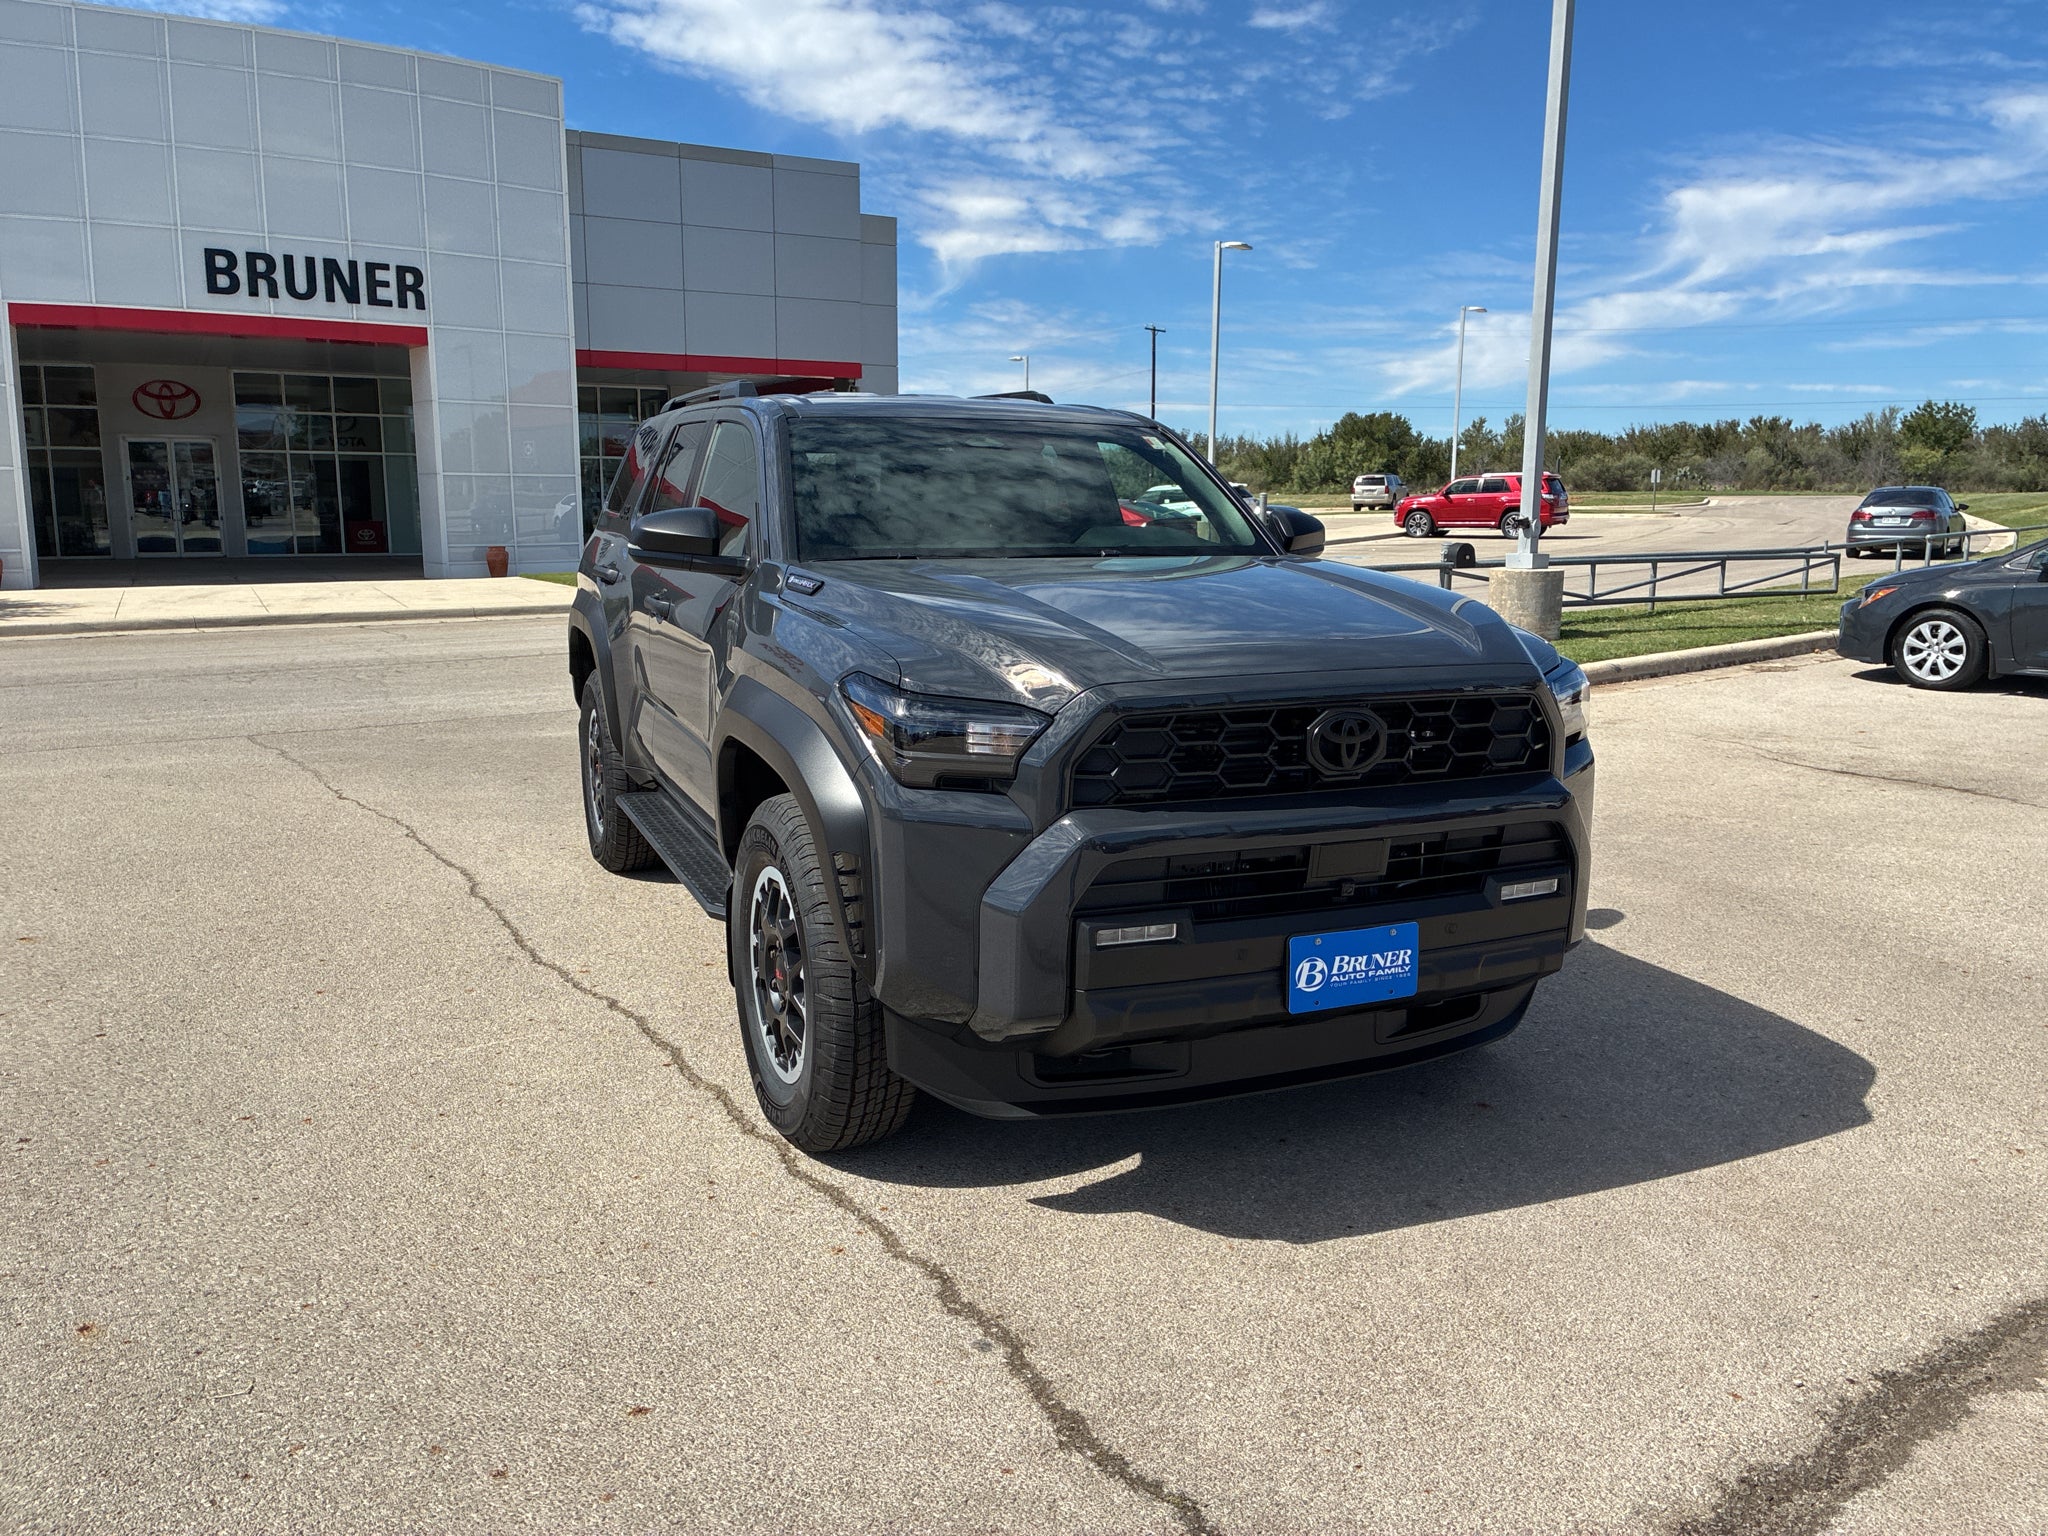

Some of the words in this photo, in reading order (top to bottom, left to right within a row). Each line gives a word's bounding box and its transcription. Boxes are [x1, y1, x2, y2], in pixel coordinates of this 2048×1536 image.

[204, 247, 426, 311] BRUNER
[1330, 949, 1412, 975] BRUNER
[1330, 972, 1366, 983] AUTO
[1368, 965, 1411, 978] FAMILY
